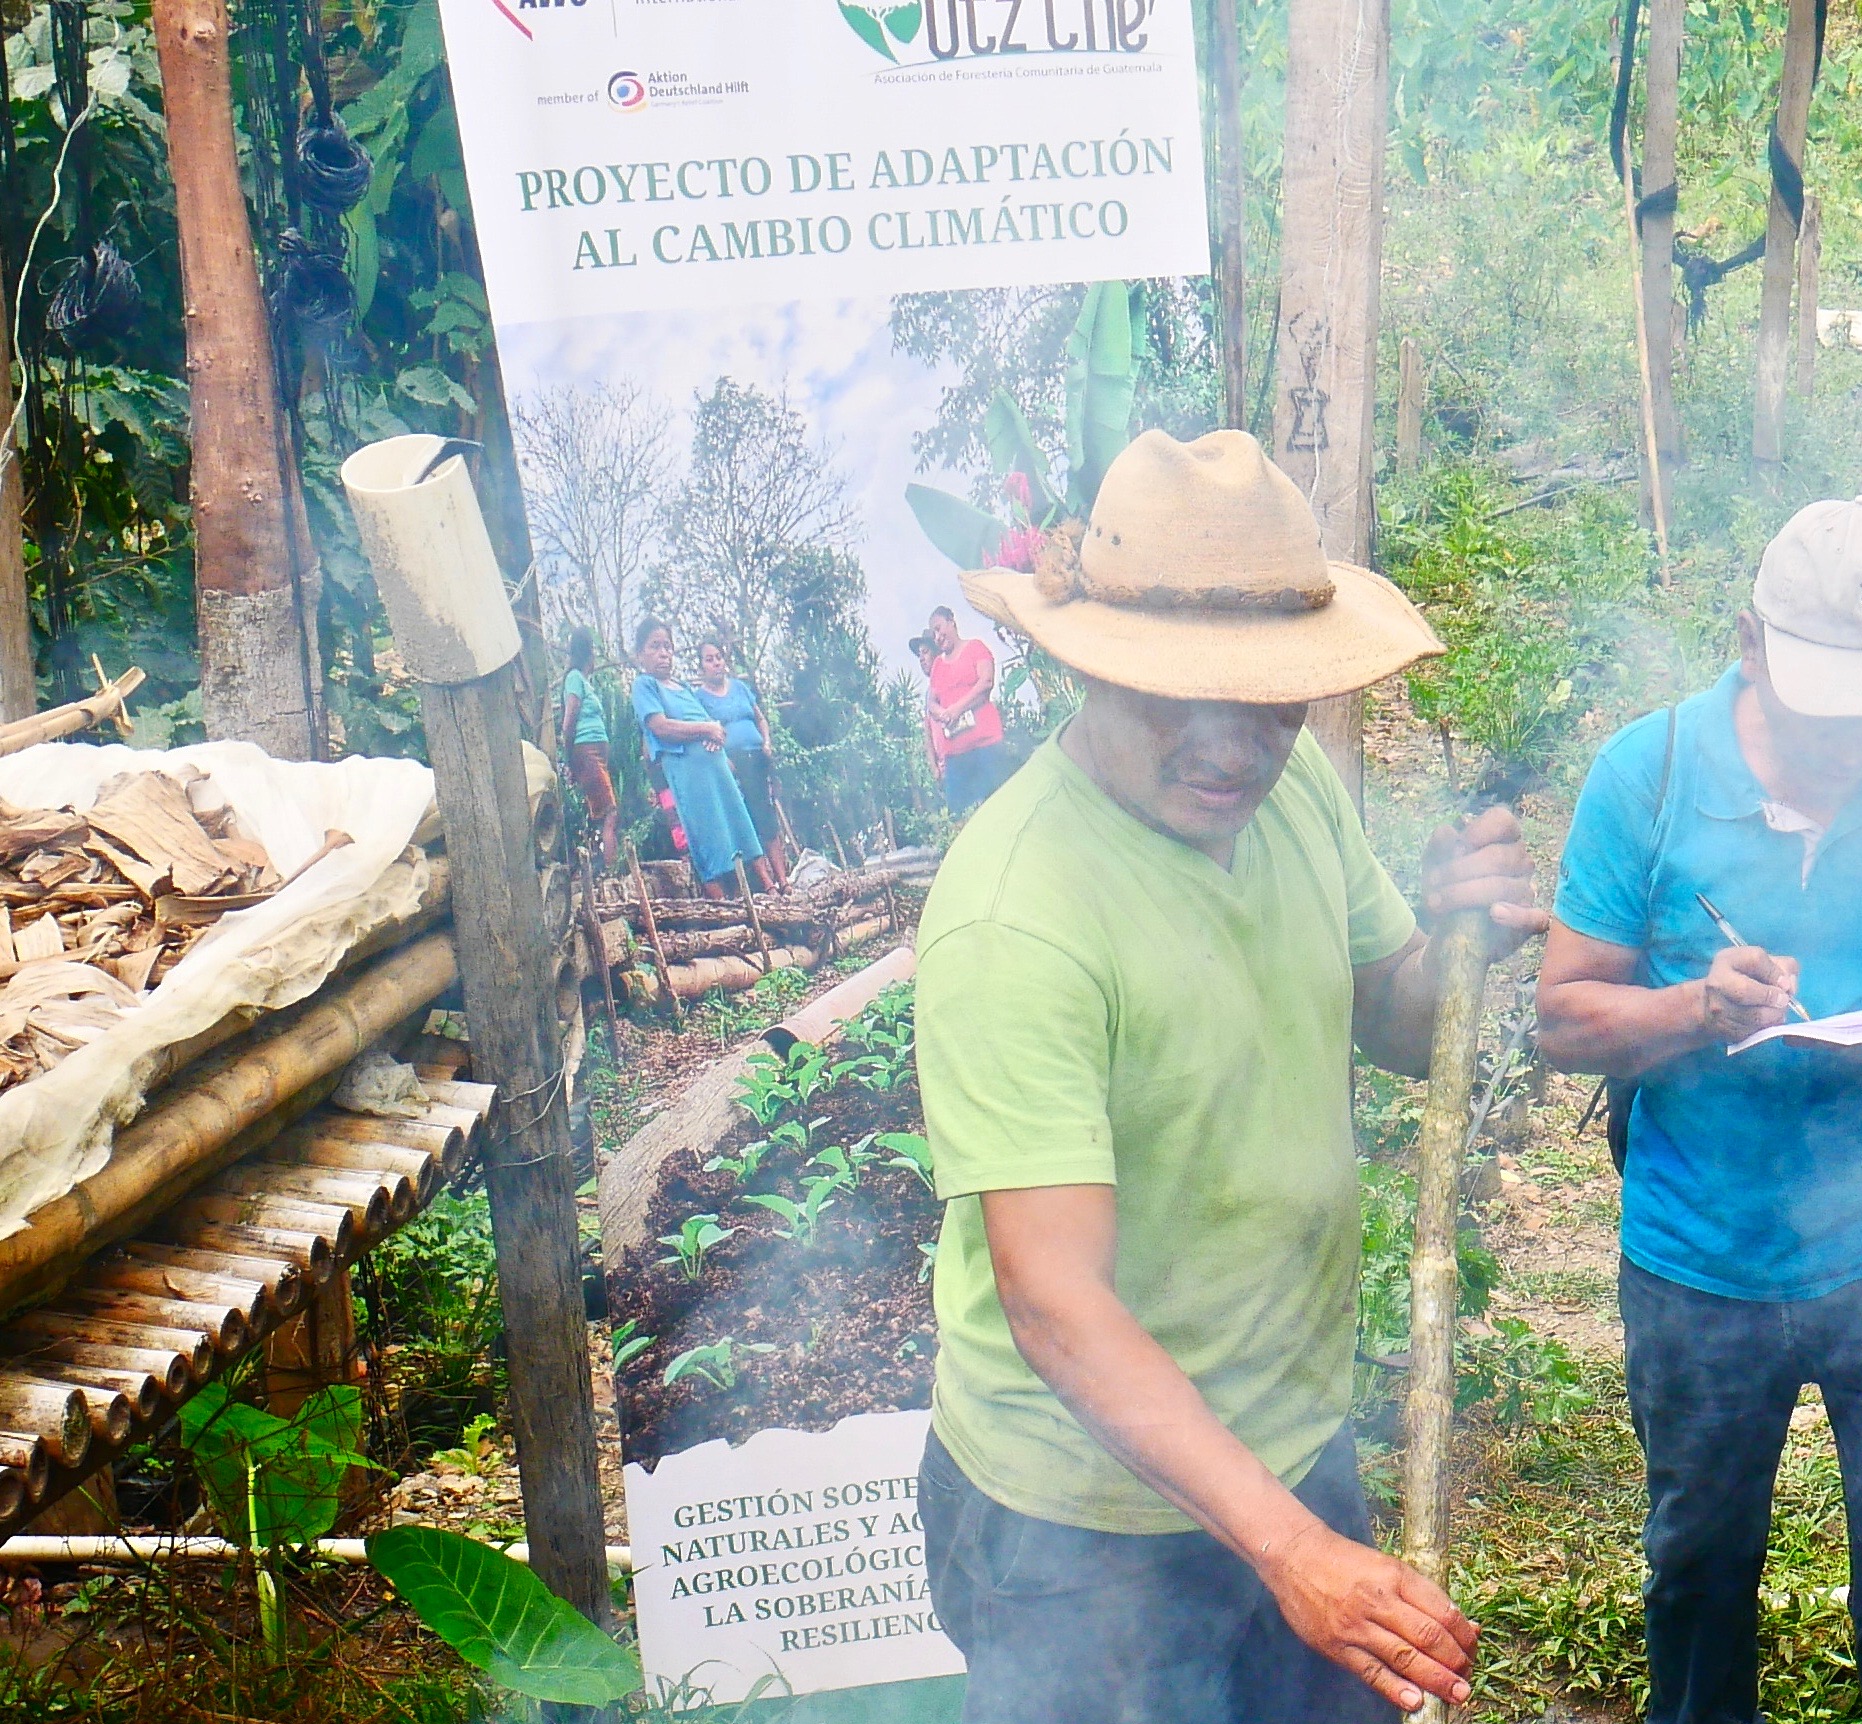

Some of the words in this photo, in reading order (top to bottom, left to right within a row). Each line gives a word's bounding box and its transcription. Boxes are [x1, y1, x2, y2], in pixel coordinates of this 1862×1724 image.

[648, 71, 687, 84] Aktion
[1015, 66, 1084, 78] Comunitaria
[1103, 62, 1162, 75] Guatemala
[537, 92, 583, 105] member
[587, 89, 598, 103] of
[649, 82, 722, 97] Deutschland
[725, 80, 749, 94] Hilft
[515, 157, 772, 212] PROYECTO
[786, 152, 855, 194] DE
[869, 128, 1174, 189] ADAPTACIÓN
[572, 228, 638, 271] AL
[652, 215, 852, 264] CAMBIO
[867, 195, 1129, 250] CLIMÁTICO
[674, 1489, 813, 1528] GESTIÓN
[660, 1519, 850, 1568] NATURALES
[857, 1515, 880, 1539] Y
[703, 1601, 747, 1629] LA
